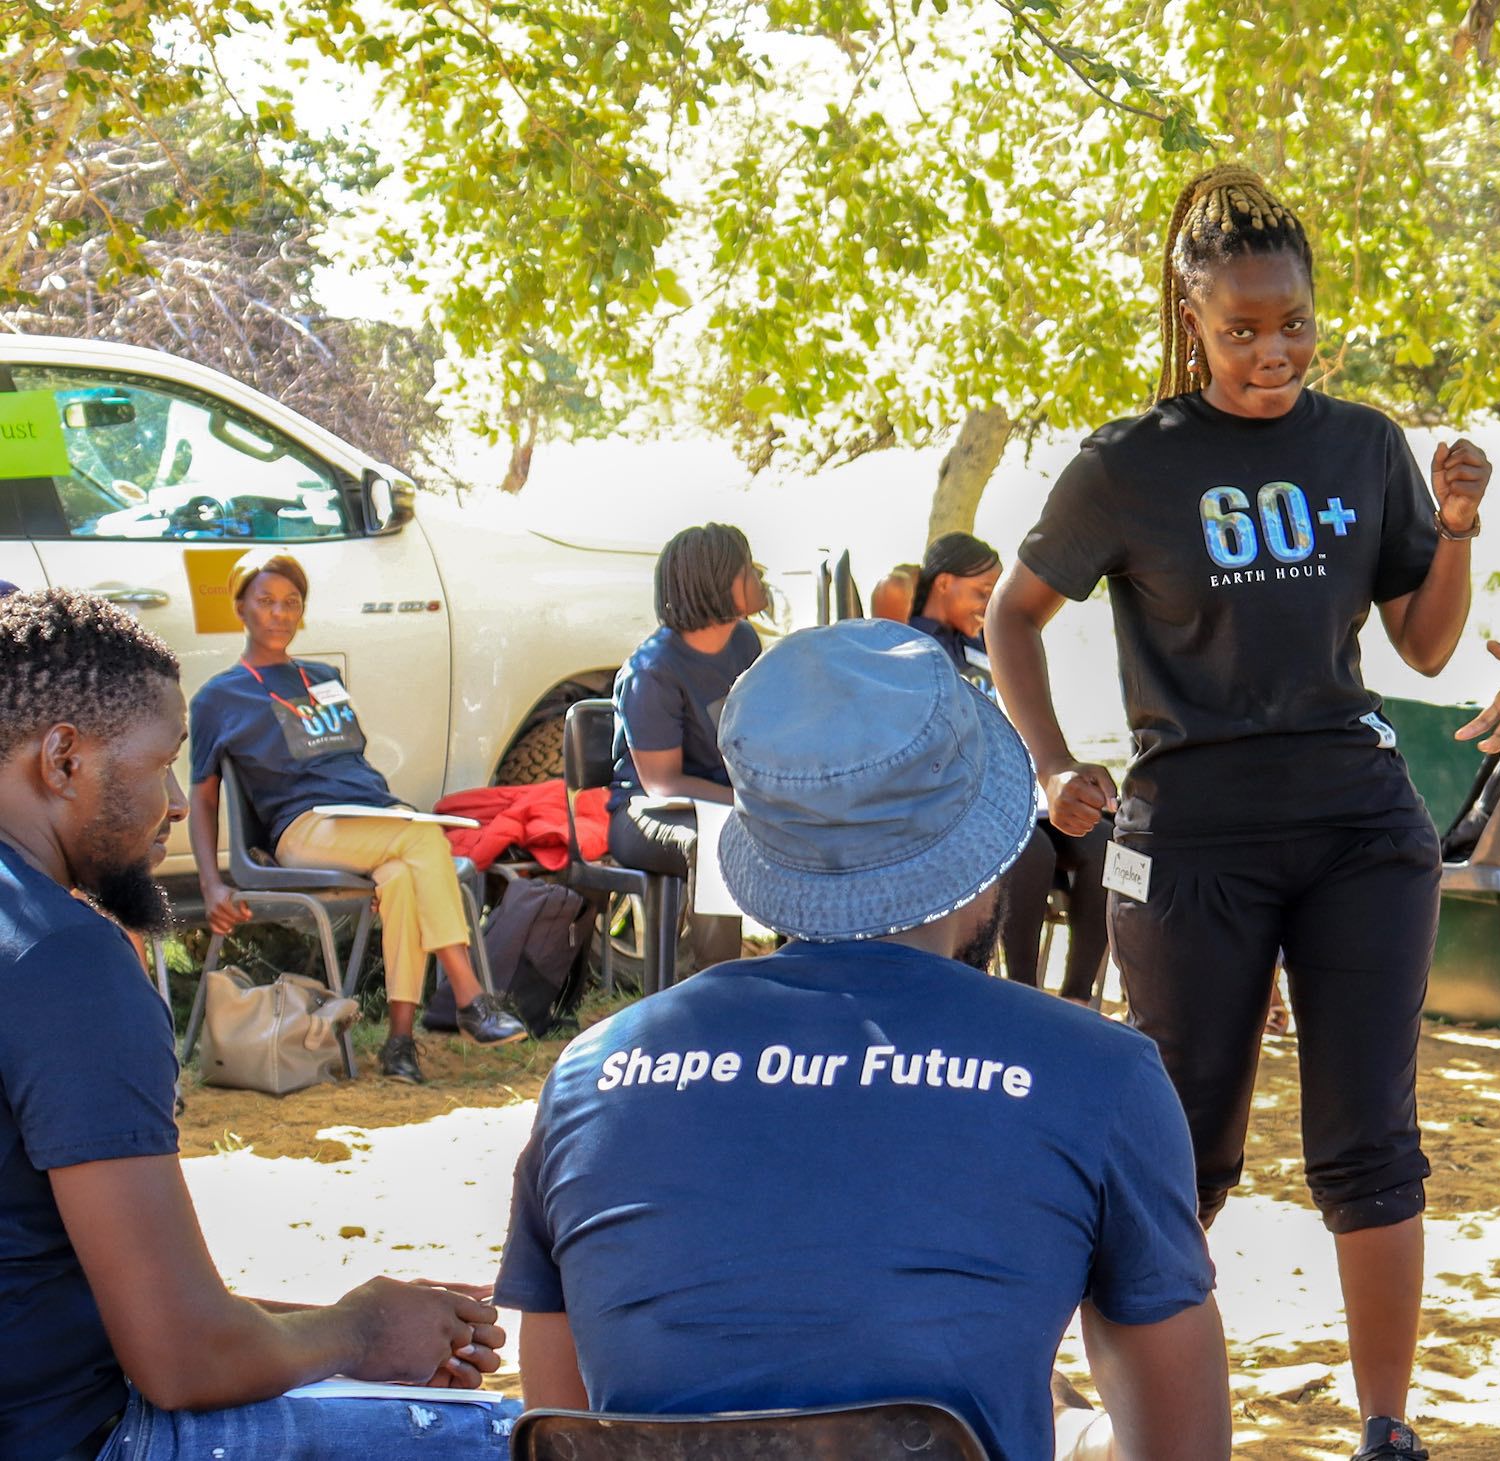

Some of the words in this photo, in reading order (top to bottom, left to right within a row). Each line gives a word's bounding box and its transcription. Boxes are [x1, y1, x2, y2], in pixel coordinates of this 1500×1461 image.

[1199, 481, 1357, 569] 60+
[1210, 569, 1266, 587] EARTH
[1275, 564, 1327, 580] HOUR
[598, 1047, 742, 1091] Shape
[756, 1045, 848, 1086] Our
[860, 1045, 1033, 1098] Future
